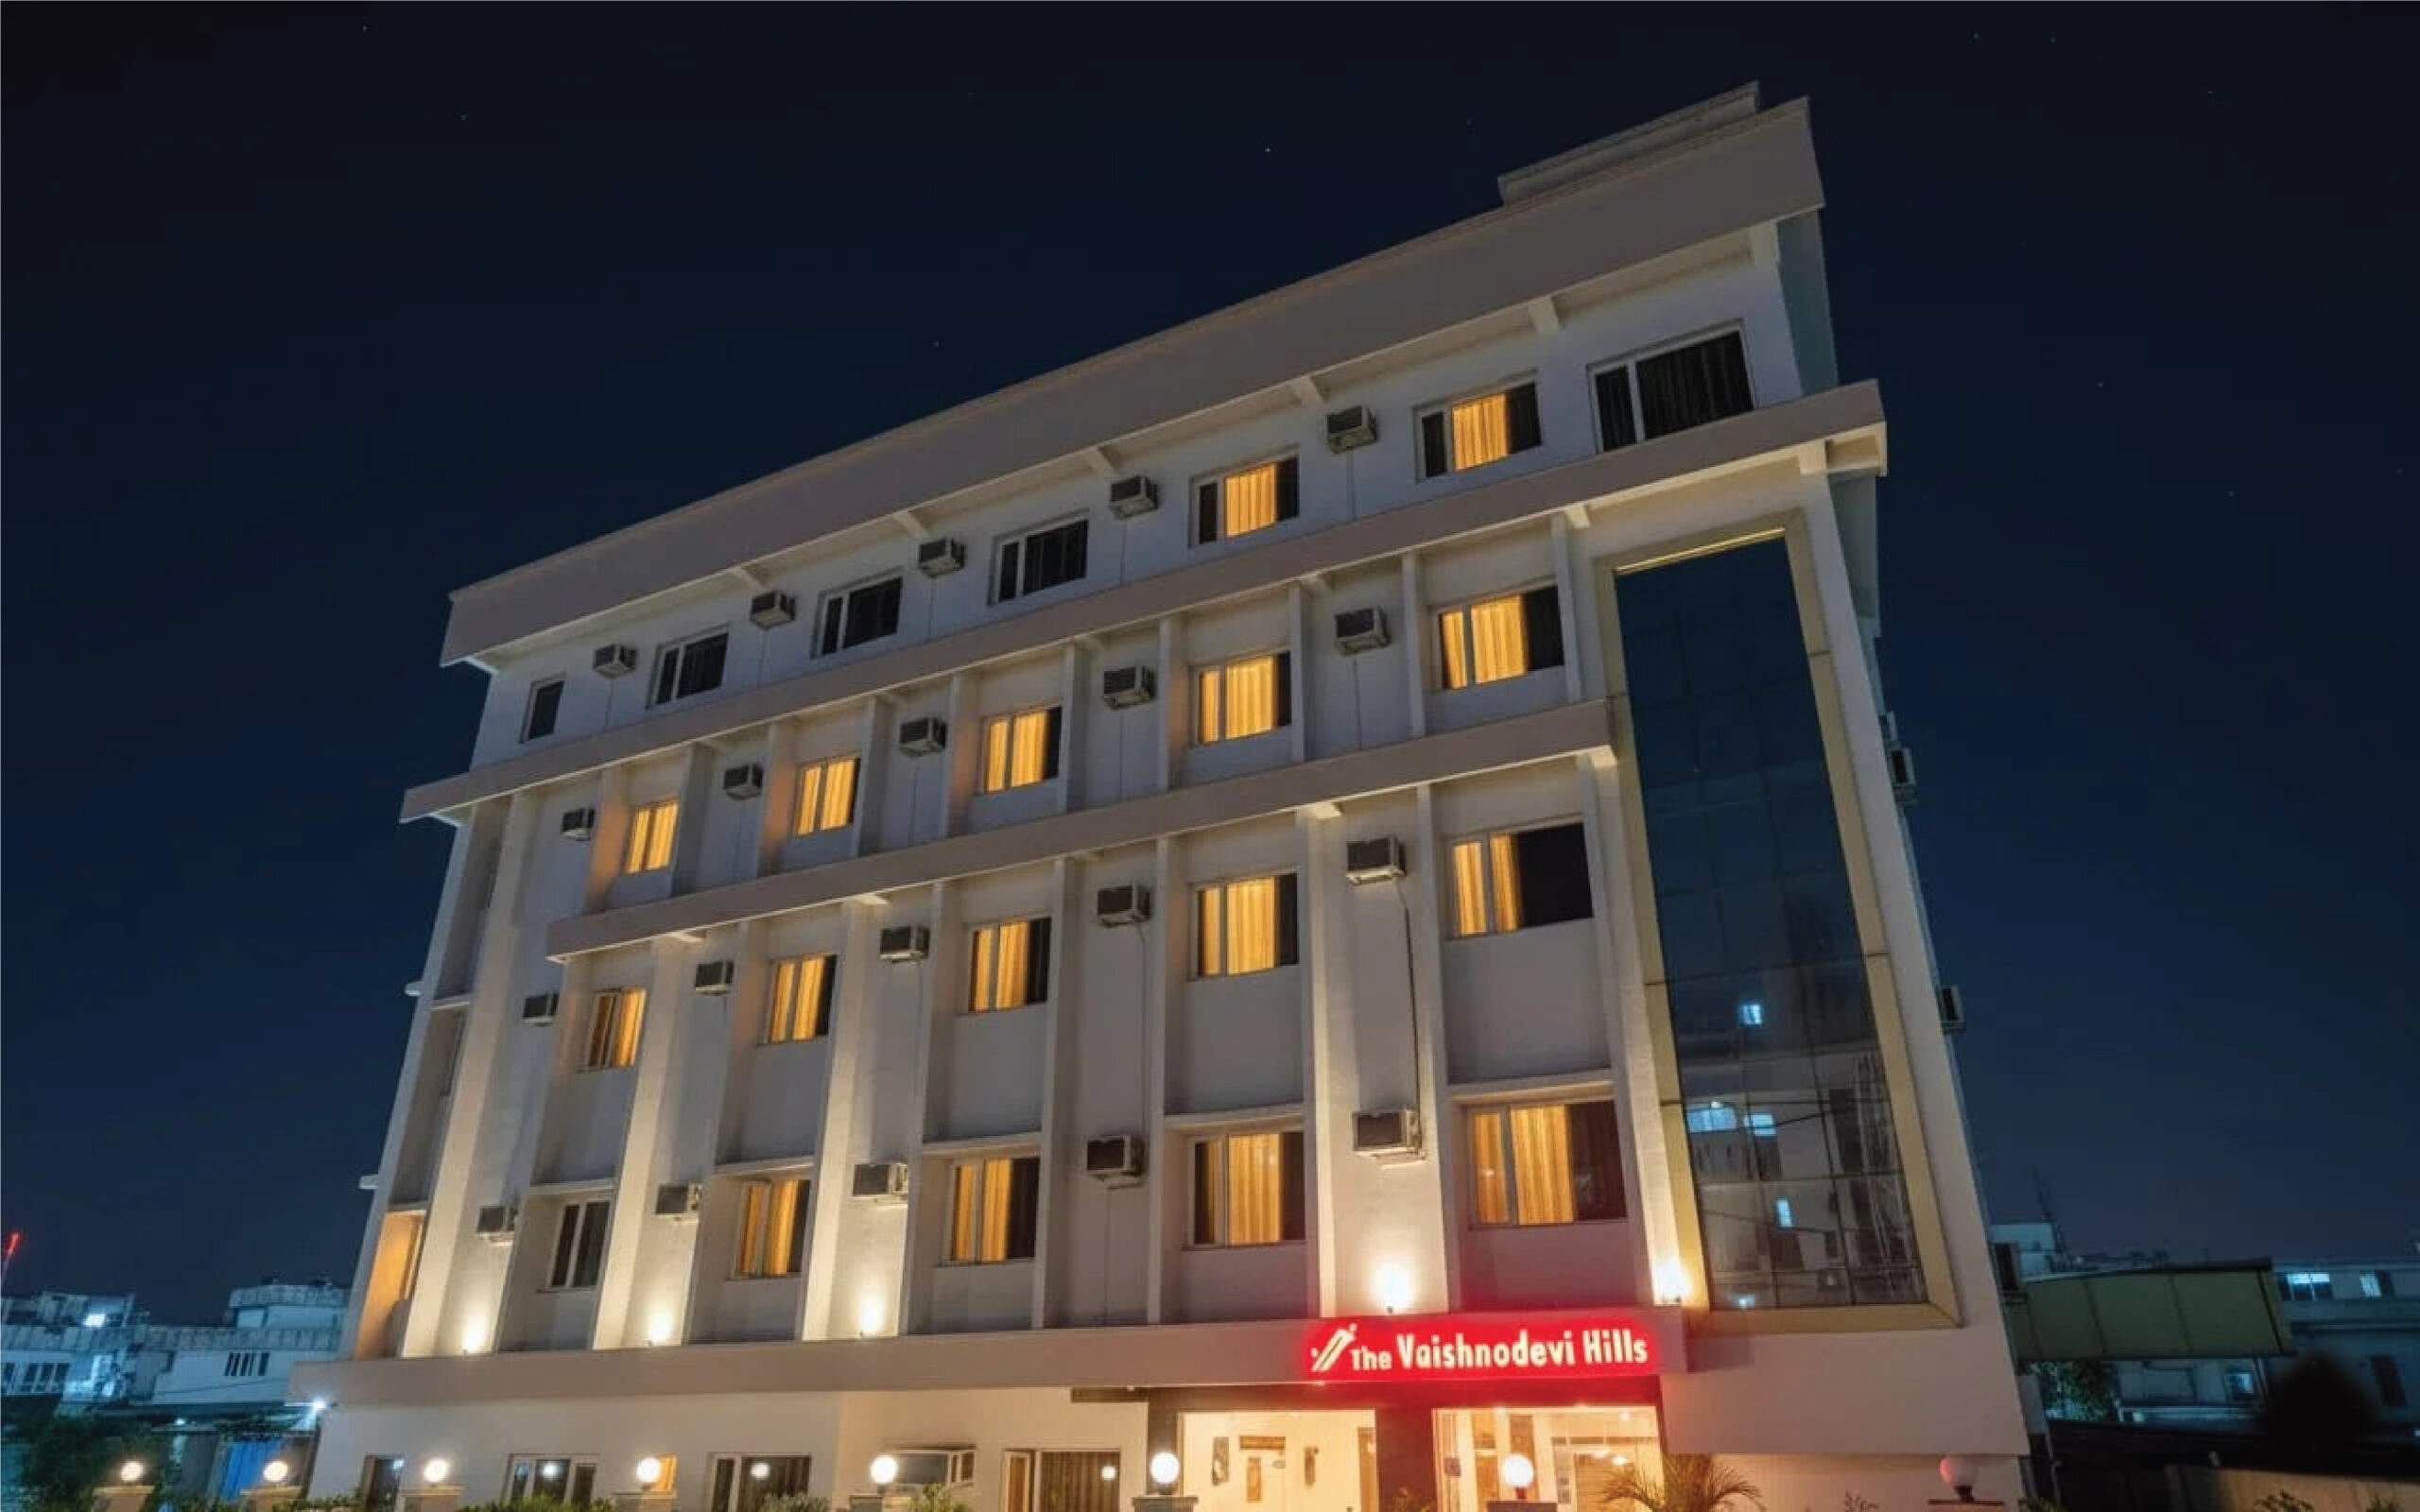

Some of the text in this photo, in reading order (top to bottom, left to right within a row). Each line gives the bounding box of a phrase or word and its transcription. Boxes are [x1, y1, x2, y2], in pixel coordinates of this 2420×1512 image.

[1351, 1330, 1649, 1370] The Vaishnodevi Hills
